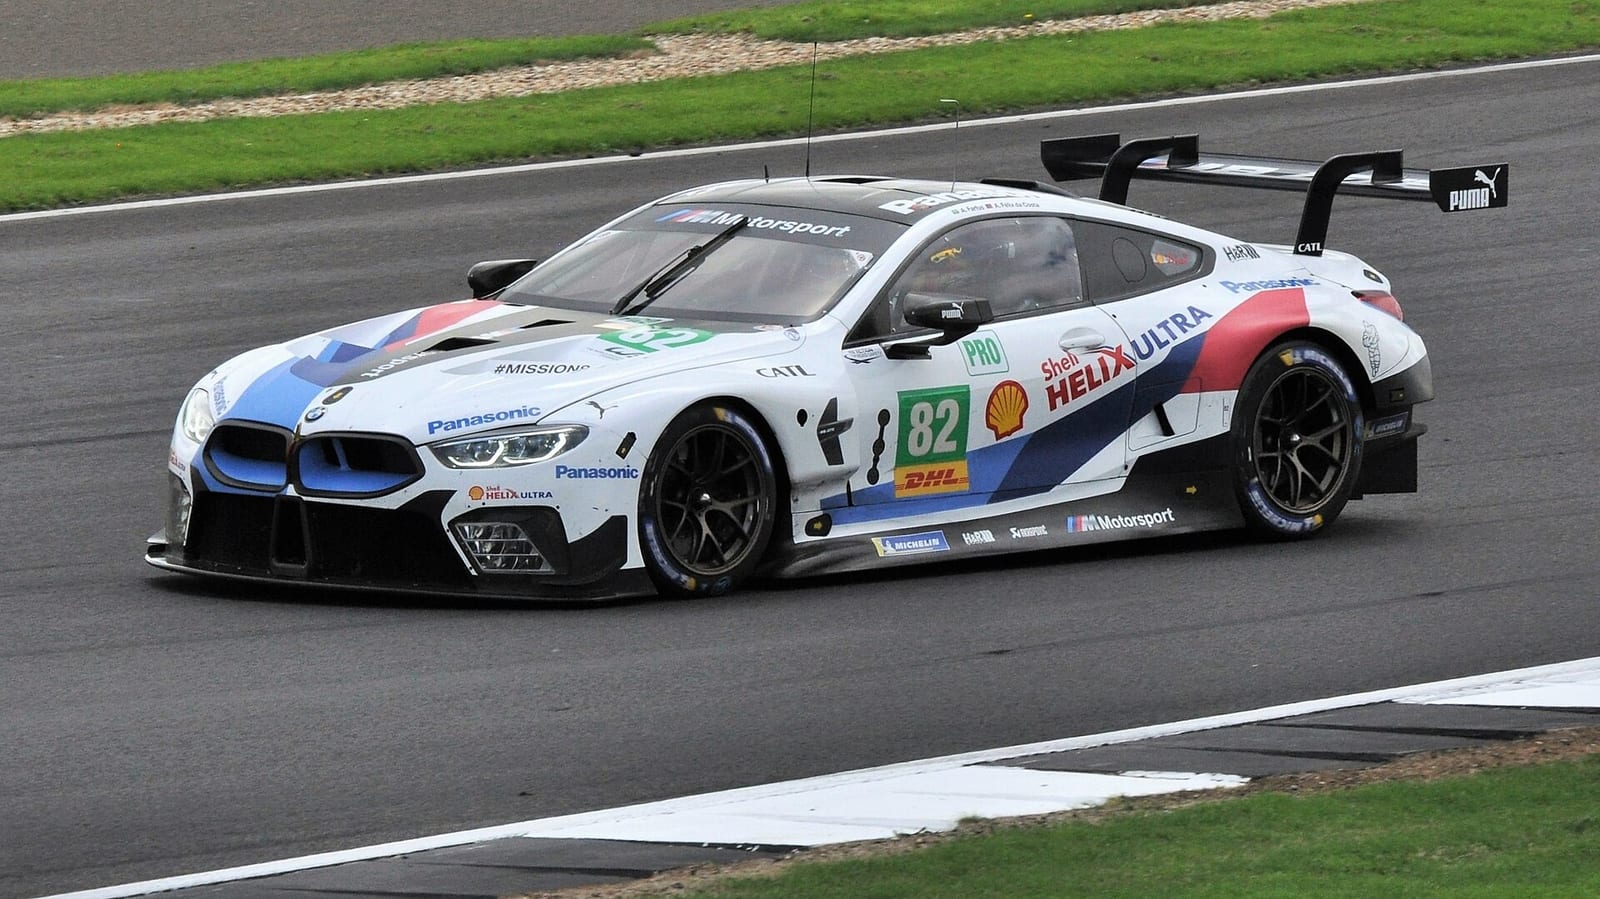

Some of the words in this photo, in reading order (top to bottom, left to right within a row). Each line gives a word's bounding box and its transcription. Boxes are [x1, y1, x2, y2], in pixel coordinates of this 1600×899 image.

[1450, 188, 1490, 211] PUMA
[1298, 242, 1323, 253] CATL
[962, 337, 1001, 367] PRO
[1044, 344, 1136, 412] HELIX
[1131, 305, 1213, 361] ULTRA
[756, 365, 817, 378] CATL
[1041, 350, 1080, 382] Shell
[428, 405, 542, 435] Panasonic
[907, 398, 960, 457] 82
[555, 464, 639, 479] Panasonic
[904, 468, 960, 490] DHL
[486, 488, 520, 500] HELIX
[520, 491, 553, 499] ULTRA
[1097, 507, 1176, 533] Motorsport
[895, 537, 940, 550] MICHELIN
